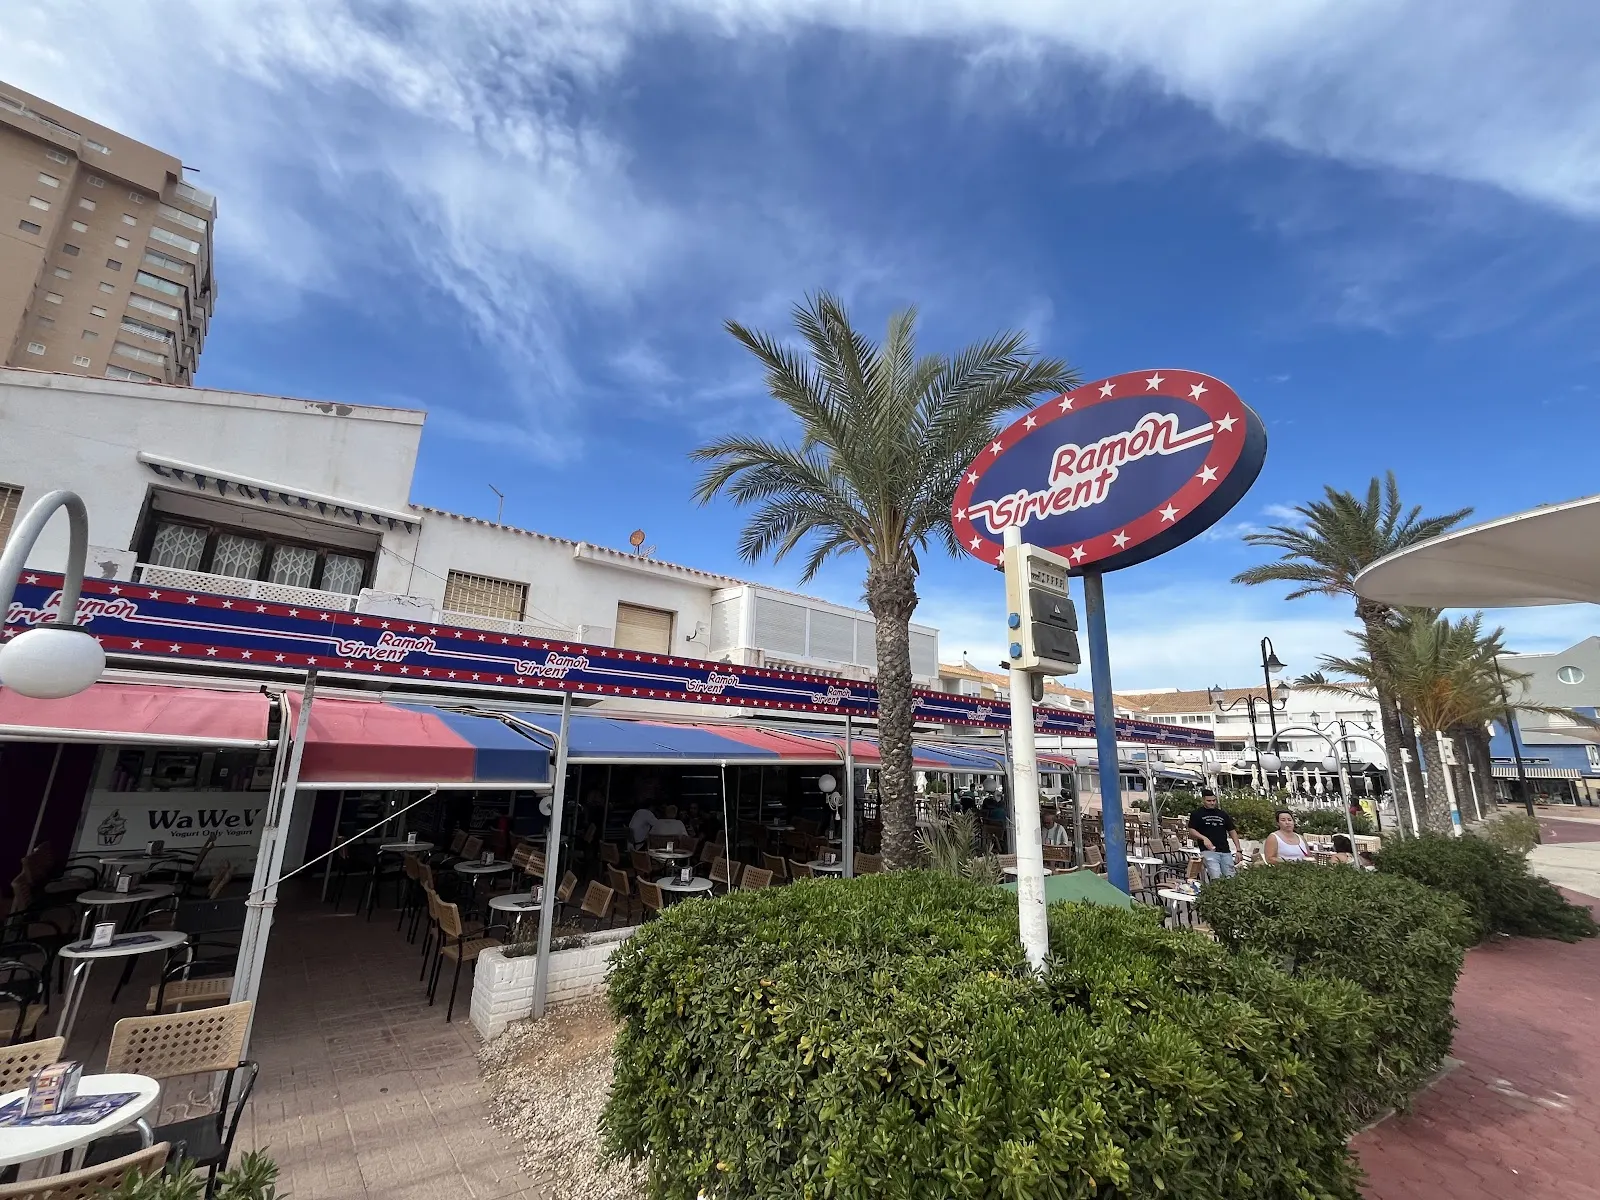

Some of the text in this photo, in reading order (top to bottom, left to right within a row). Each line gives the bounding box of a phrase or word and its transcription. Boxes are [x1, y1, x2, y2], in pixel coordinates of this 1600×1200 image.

[988, 467, 1115, 531] Sirvent
[337, 641, 407, 661] Sirvent
[515, 661, 569, 679] Sirvent
[687, 681, 725, 695] Sirvent
[170, 830, 199, 838] Yogurt
